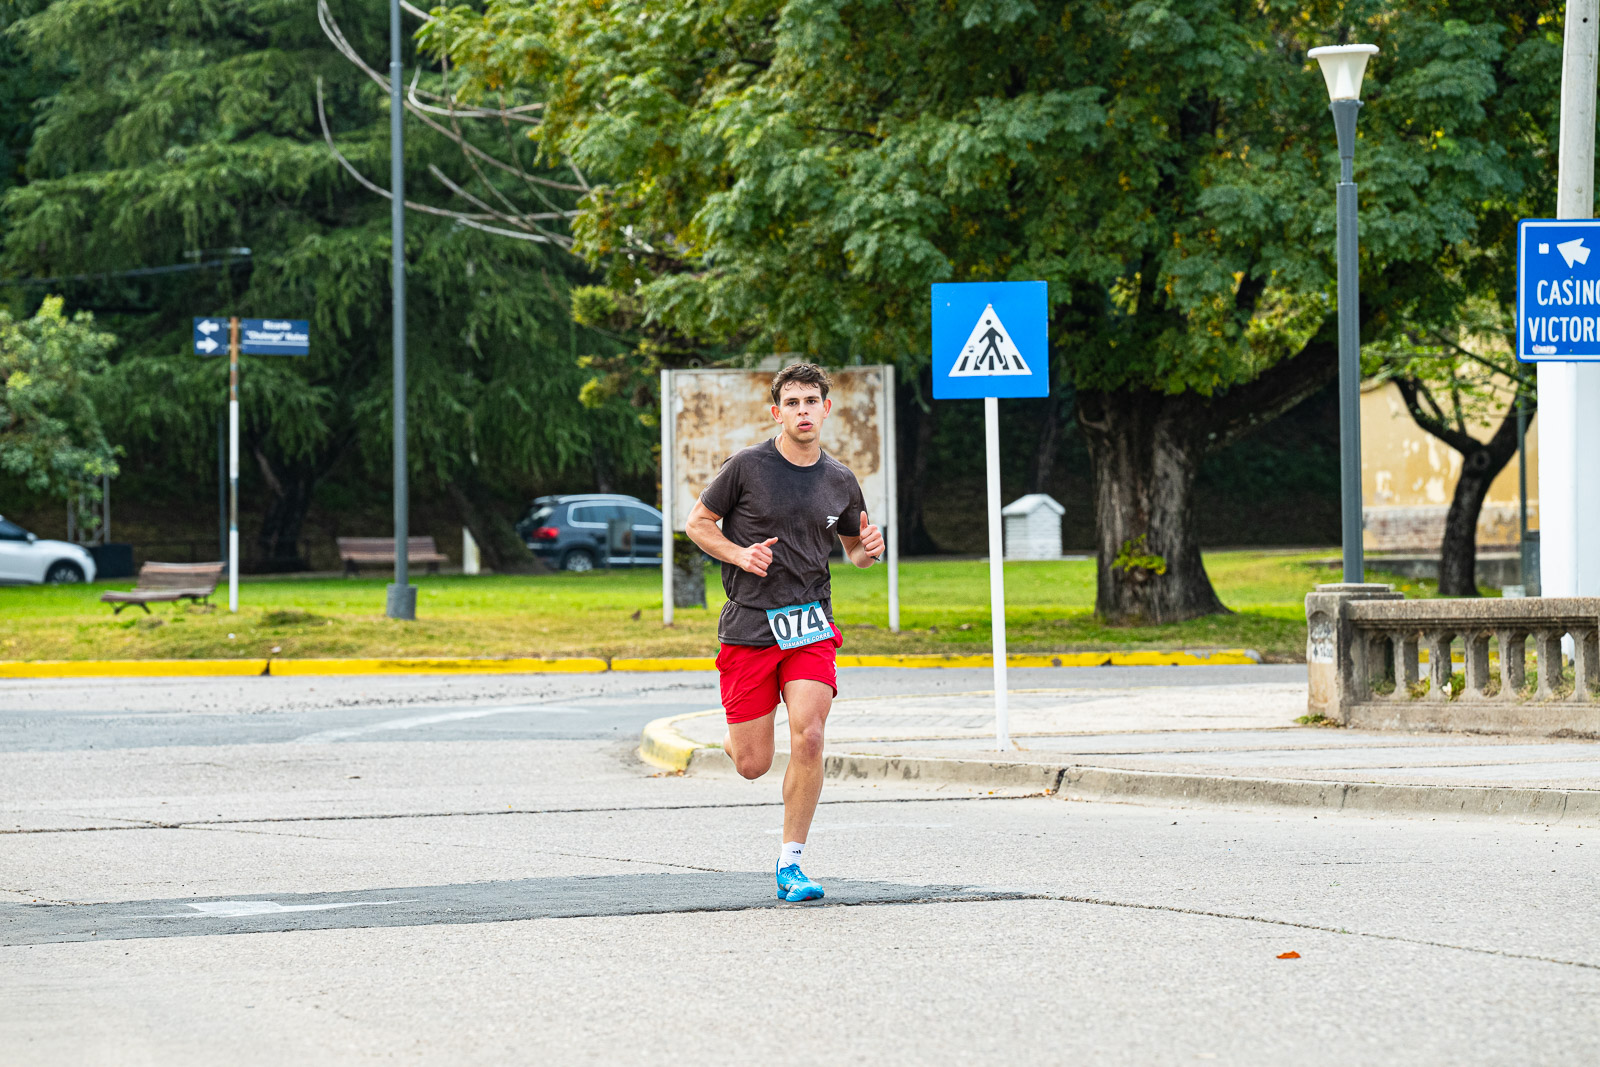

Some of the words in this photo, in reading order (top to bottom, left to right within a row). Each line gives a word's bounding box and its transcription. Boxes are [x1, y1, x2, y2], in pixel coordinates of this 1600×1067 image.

[773, 605, 825, 641] 074
[782, 637, 811, 648] DIAMANTE
[812, 631, 831, 641] CORRE
